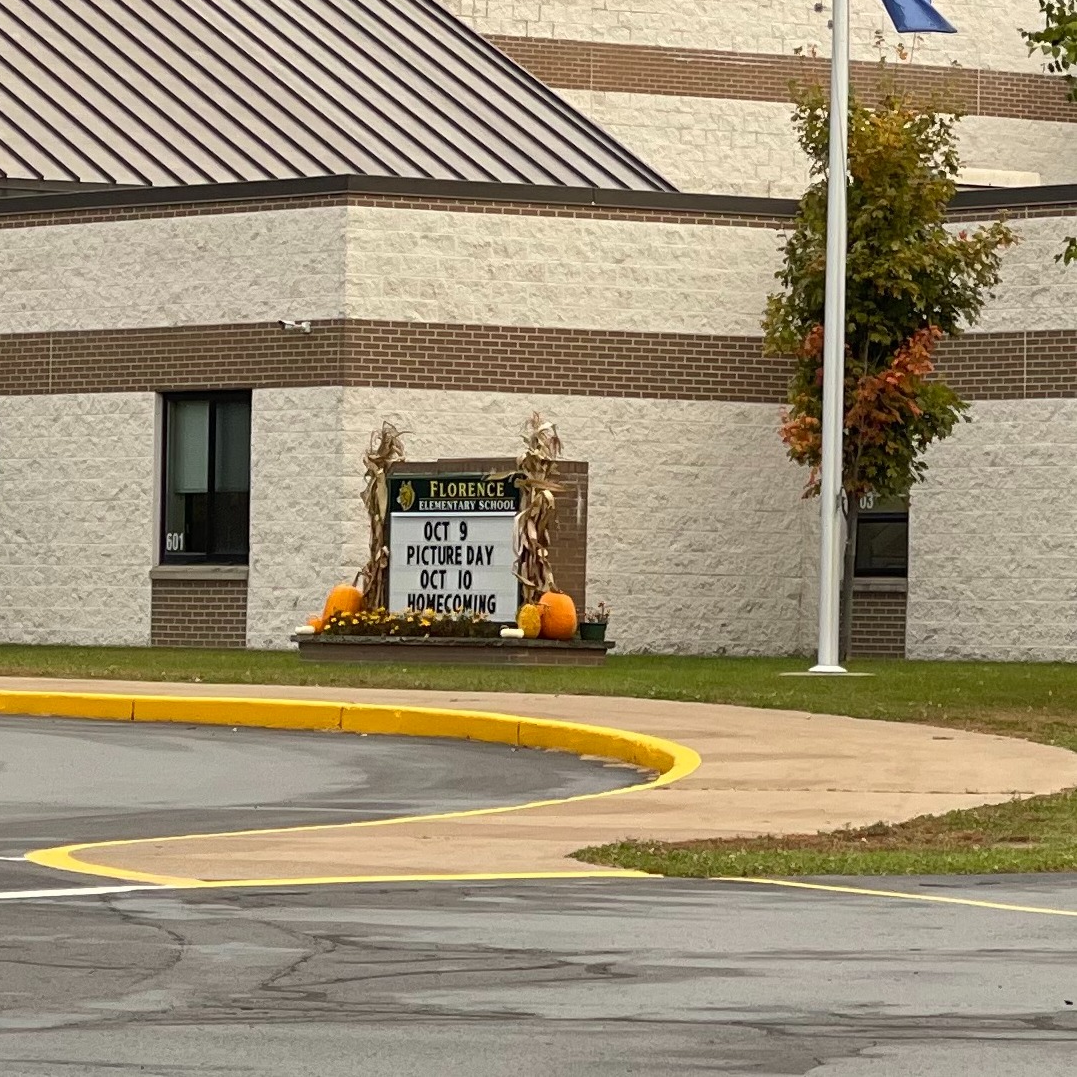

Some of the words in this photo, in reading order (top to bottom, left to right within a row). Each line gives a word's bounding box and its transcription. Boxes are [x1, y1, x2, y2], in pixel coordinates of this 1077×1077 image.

[430, 480, 505, 498] FLORENCE
[418, 500, 476, 511] ELEMENTARY
[478, 499, 516, 510] SCHOOL
[424, 521, 450, 541] OCT
[459, 521, 468, 541] 9
[166, 532, 184, 551] 601
[406, 545, 463, 565] PICTURE
[466, 545, 494, 565] DAY
[420, 569, 447, 590] OCT
[457, 569, 473, 590] 10
[407, 593, 497, 614] HOMECOMING
